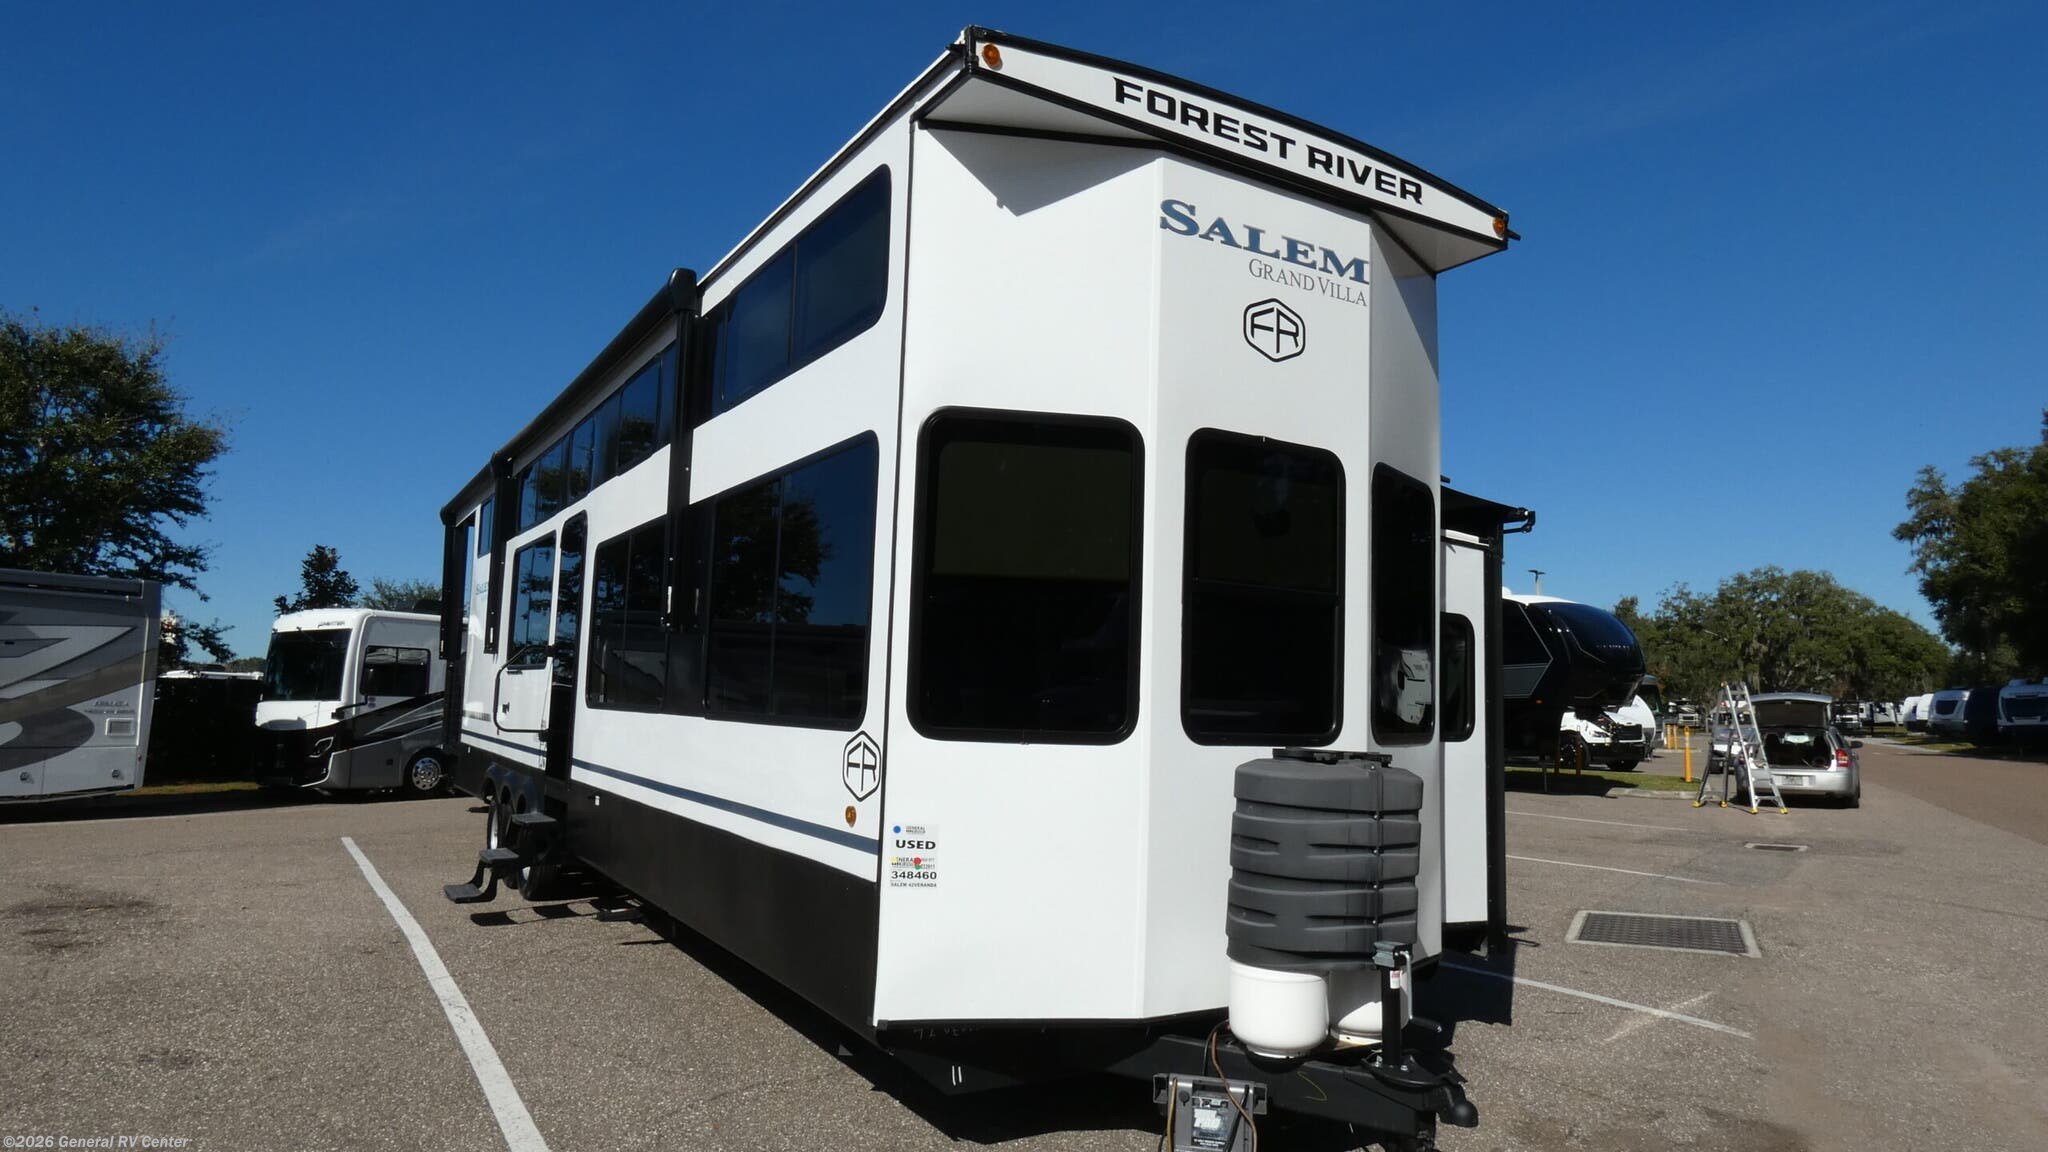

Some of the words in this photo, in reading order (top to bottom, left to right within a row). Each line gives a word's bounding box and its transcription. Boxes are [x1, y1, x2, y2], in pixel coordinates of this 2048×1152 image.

[1113, 77, 1296, 159] FOREST
[1306, 145, 1423, 205] RIVER
[1160, 199, 1370, 285] SALEM
[1249, 259, 1315, 291] GRAND
[1318, 276, 1367, 307] VILLA
[896, 839, 936, 849] USED
[891, 870, 937, 880] 348460
